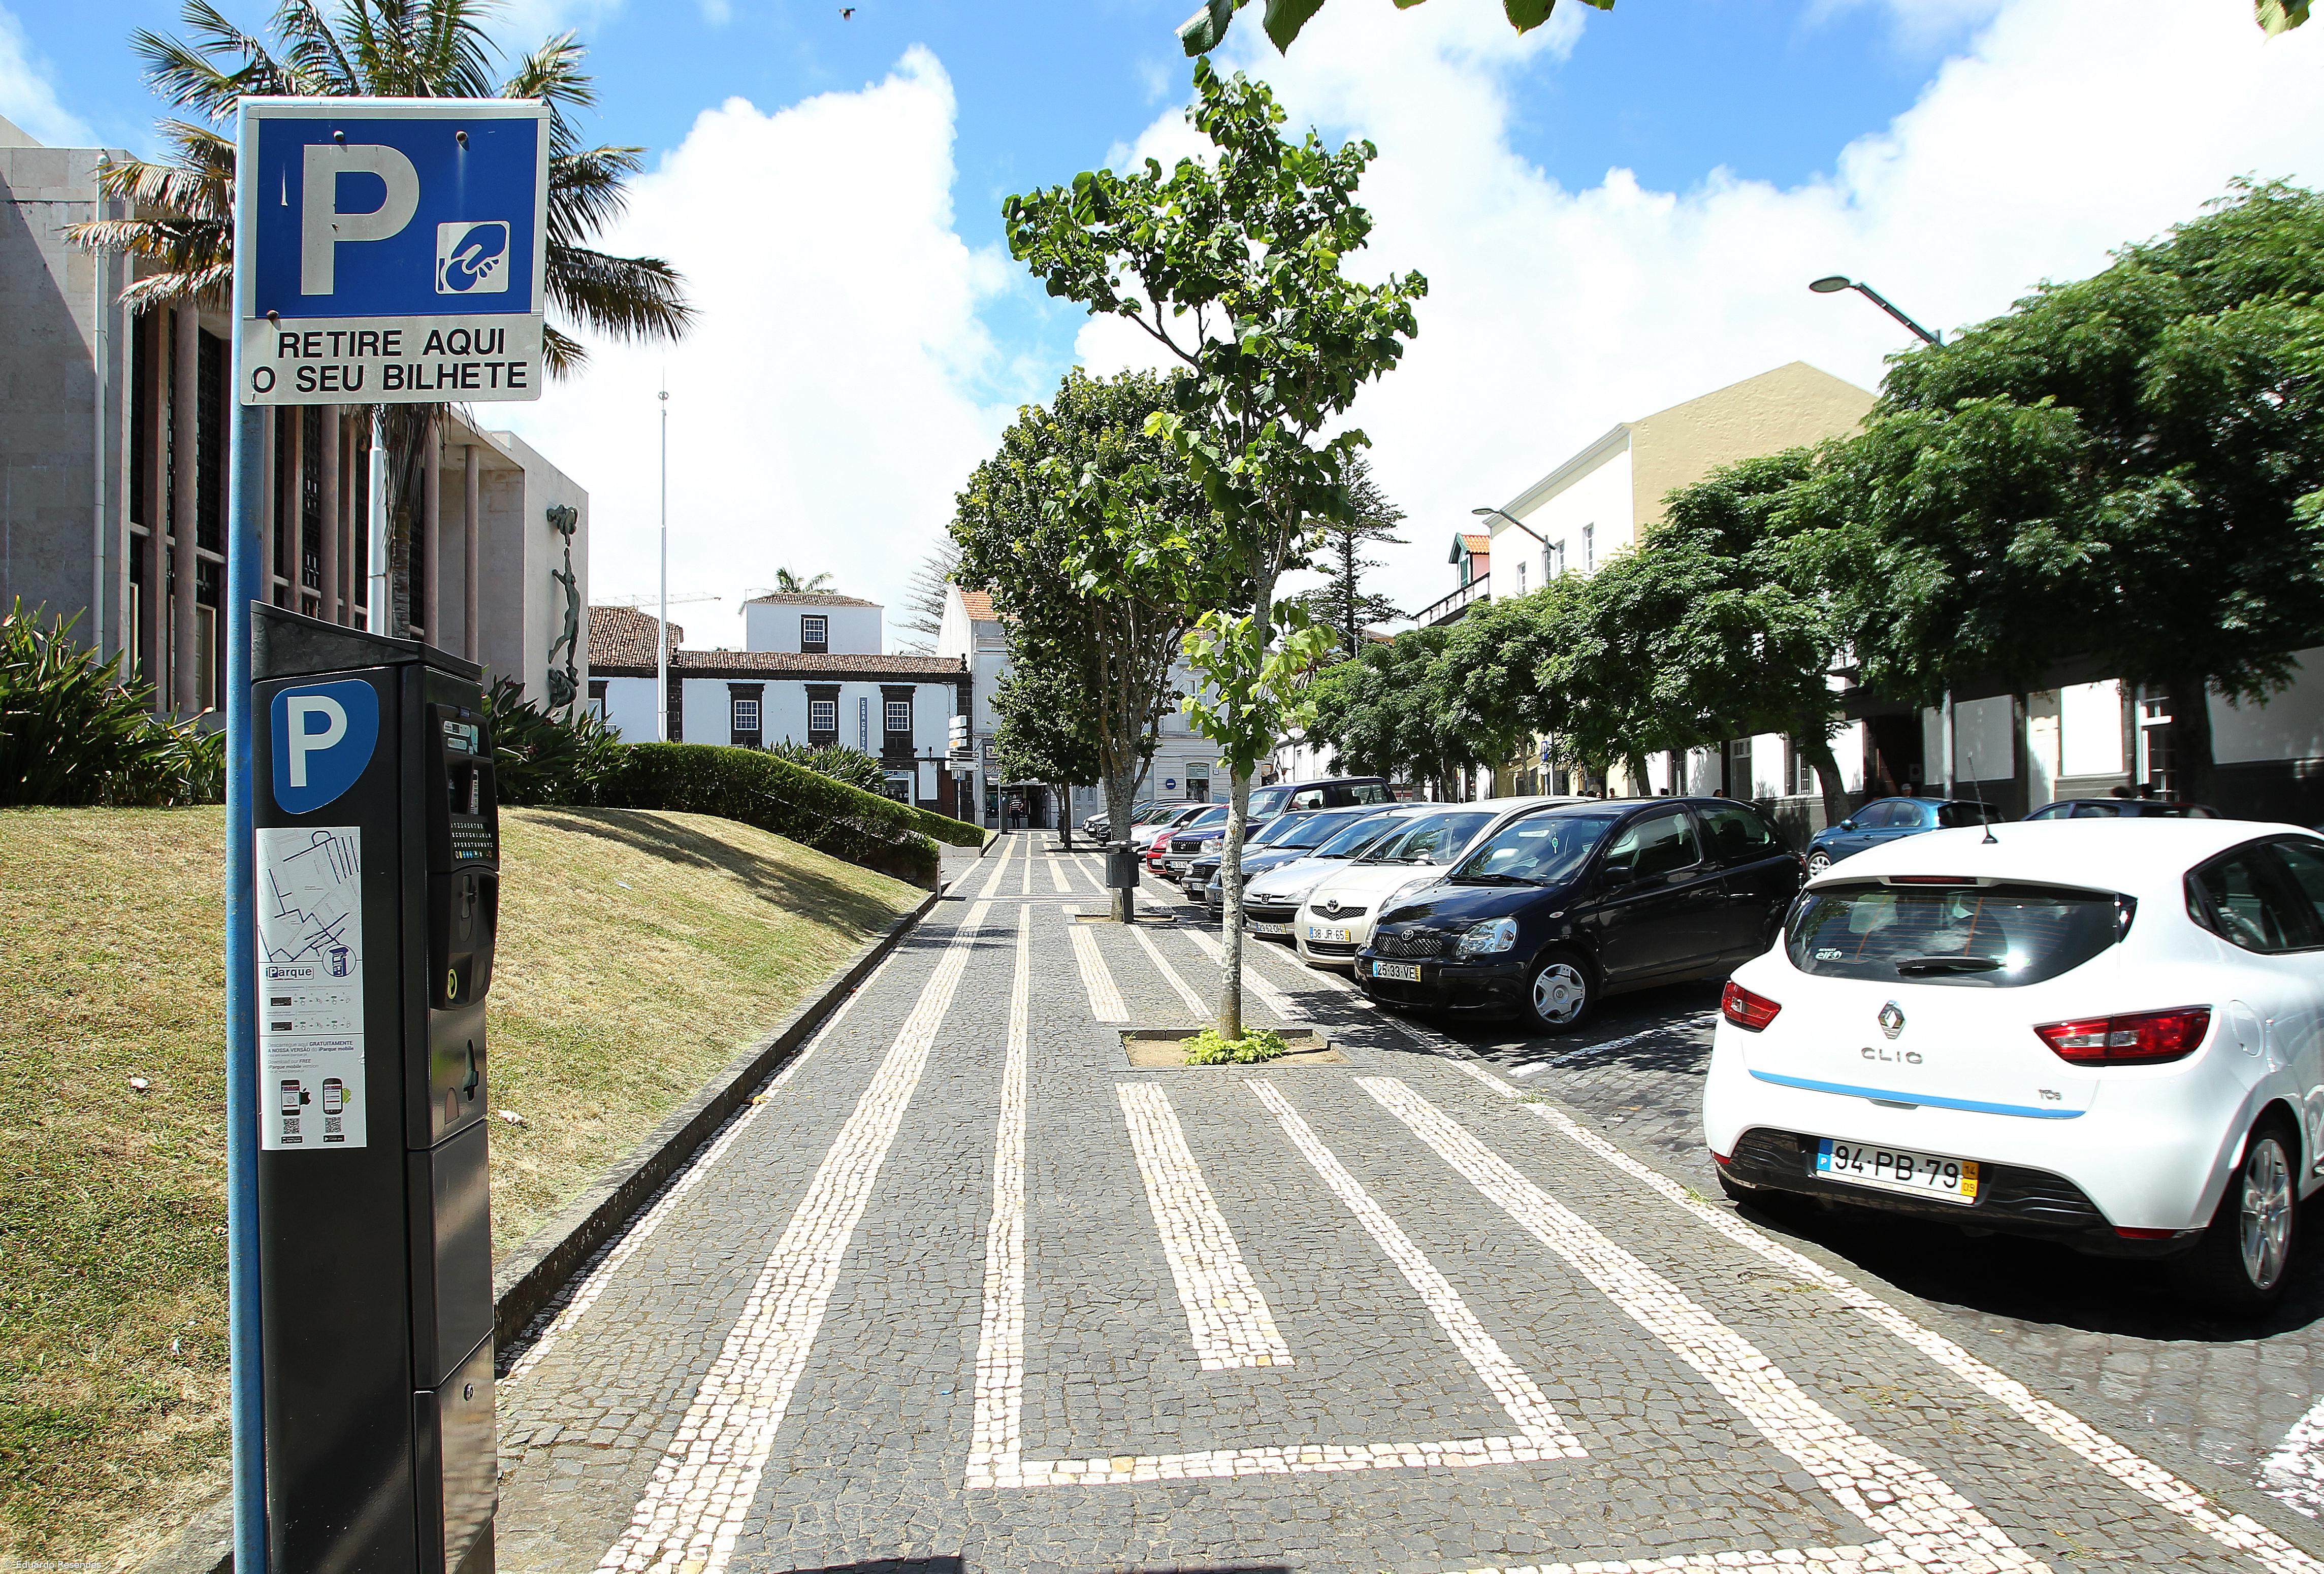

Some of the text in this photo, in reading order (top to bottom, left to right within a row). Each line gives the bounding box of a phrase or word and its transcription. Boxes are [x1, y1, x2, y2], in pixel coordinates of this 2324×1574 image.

[301, 144, 420, 296] P
[278, 327, 504, 358] RETIRE AQUI
[252, 362, 528, 394] O SEU BILHETE
[287, 696, 348, 788] P
[1861, 1047, 1923, 1064] CLIO
[1835, 1145, 1959, 1189] 94-PB-79
